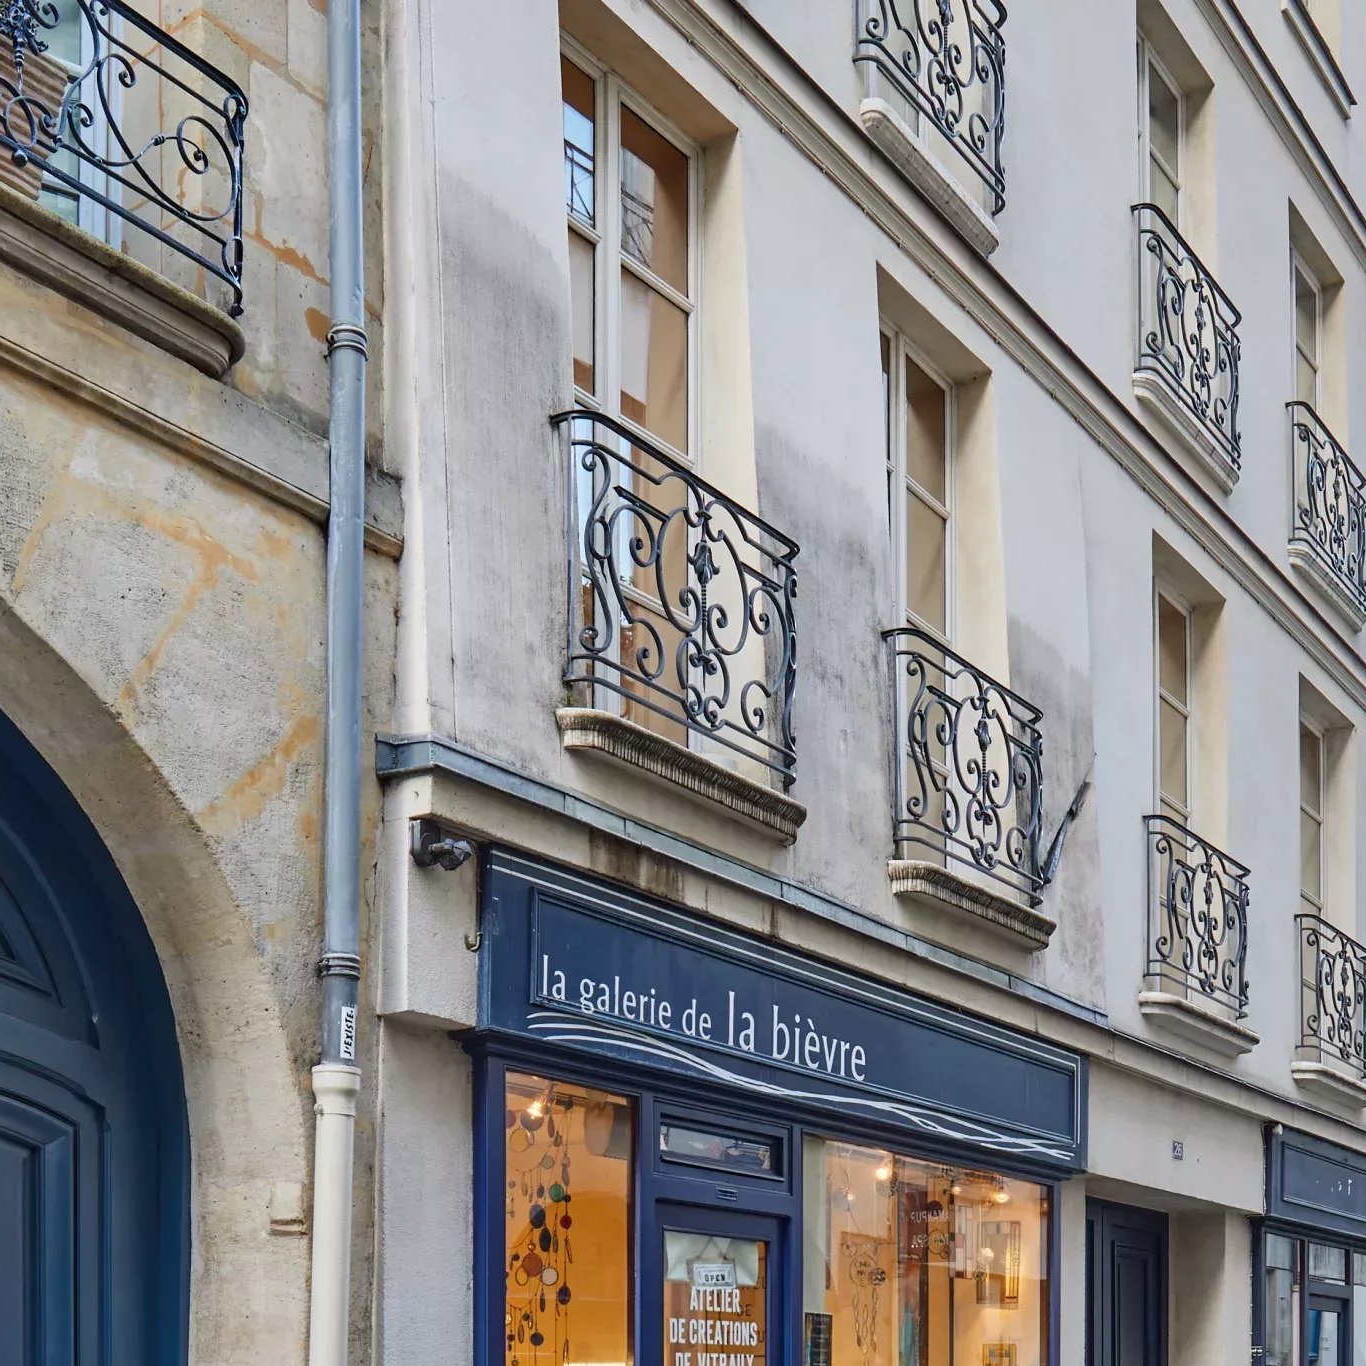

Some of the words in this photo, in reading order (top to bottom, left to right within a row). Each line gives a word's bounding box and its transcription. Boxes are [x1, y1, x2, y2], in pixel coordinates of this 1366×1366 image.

[541, 954, 567, 1001] la
[578, 975, 672, 1029] galerie
[681, 998, 713, 1041] de
[728, 990, 755, 1052] la
[772, 1004, 867, 1082] bièvre
[704, 1274, 726, 1282] OPEN
[690, 1286, 741, 1313] ATELIER
[669, 1318, 686, 1344] DE
[689, 1319, 758, 1347] CREATIONS
